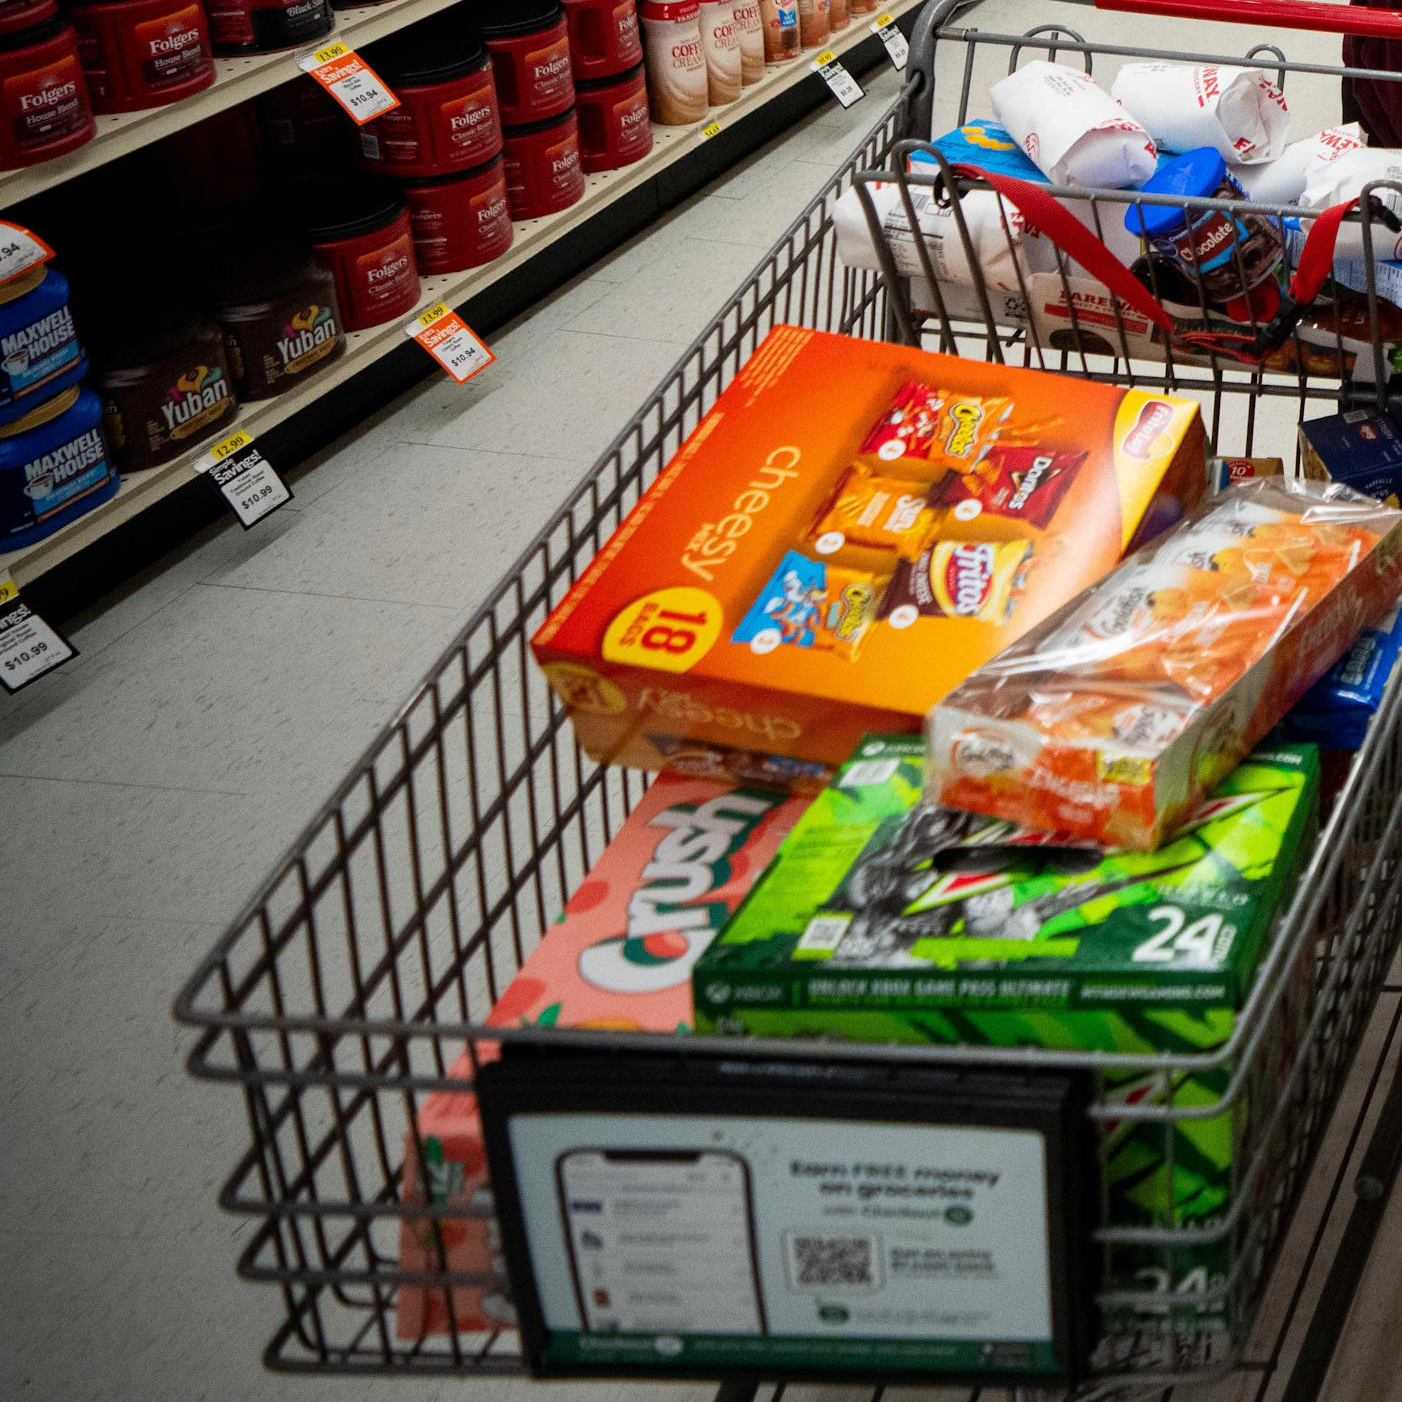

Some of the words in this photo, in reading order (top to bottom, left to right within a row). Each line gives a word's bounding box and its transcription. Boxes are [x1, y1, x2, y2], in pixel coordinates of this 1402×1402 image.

[150, 28, 200, 55] Folgers
[154, 53, 180, 68] House
[320, 59, 363, 84] Savings!
[534, 55, 569, 79] Folgers
[20, 80, 77, 111] Folgers
[350, 89, 379, 107] $10.94
[26, 108, 57, 126] House
[451, 105, 491, 130] Folgers
[621, 104, 648, 128] Folgers
[552, 150, 579, 174] Folgers
[477, 198, 507, 222] Folgers
[1180, 222, 1234, 263] Cocolate
[368, 255, 408, 283] Folgers
[1, 305, 72, 355] MAXWELL
[422, 306, 445, 325] 13.99
[29, 320, 76, 360] HOUSE
[276, 317, 337, 365] Yuban
[426, 319, 461, 348] Savings!
[451, 347, 476, 367] $10.94
[161, 379, 229, 431] Yuban
[215, 434, 245, 458] 12.99
[946, 403, 984, 458] Cheetos
[24, 428, 102, 482] MAXWELL
[53, 442, 105, 484] HOUSE
[208, 457, 236, 477] Simple
[213, 449, 263, 485] Savings!
[1007, 454, 1052, 511] Doritos
[1230, 466, 1247, 478] 10
[241, 484, 274, 511] $10.99
[681, 444, 803, 584] cheesy
[947, 543, 996, 617] Fritos
[619, 601, 653, 649] BAGS
[834, 582, 874, 643] Cheetos
[639, 606, 708, 657] 18
[4, 641, 49, 672] $10.99
[579, 793, 774, 993] Crush
[1132, 905, 1228, 964] 24
